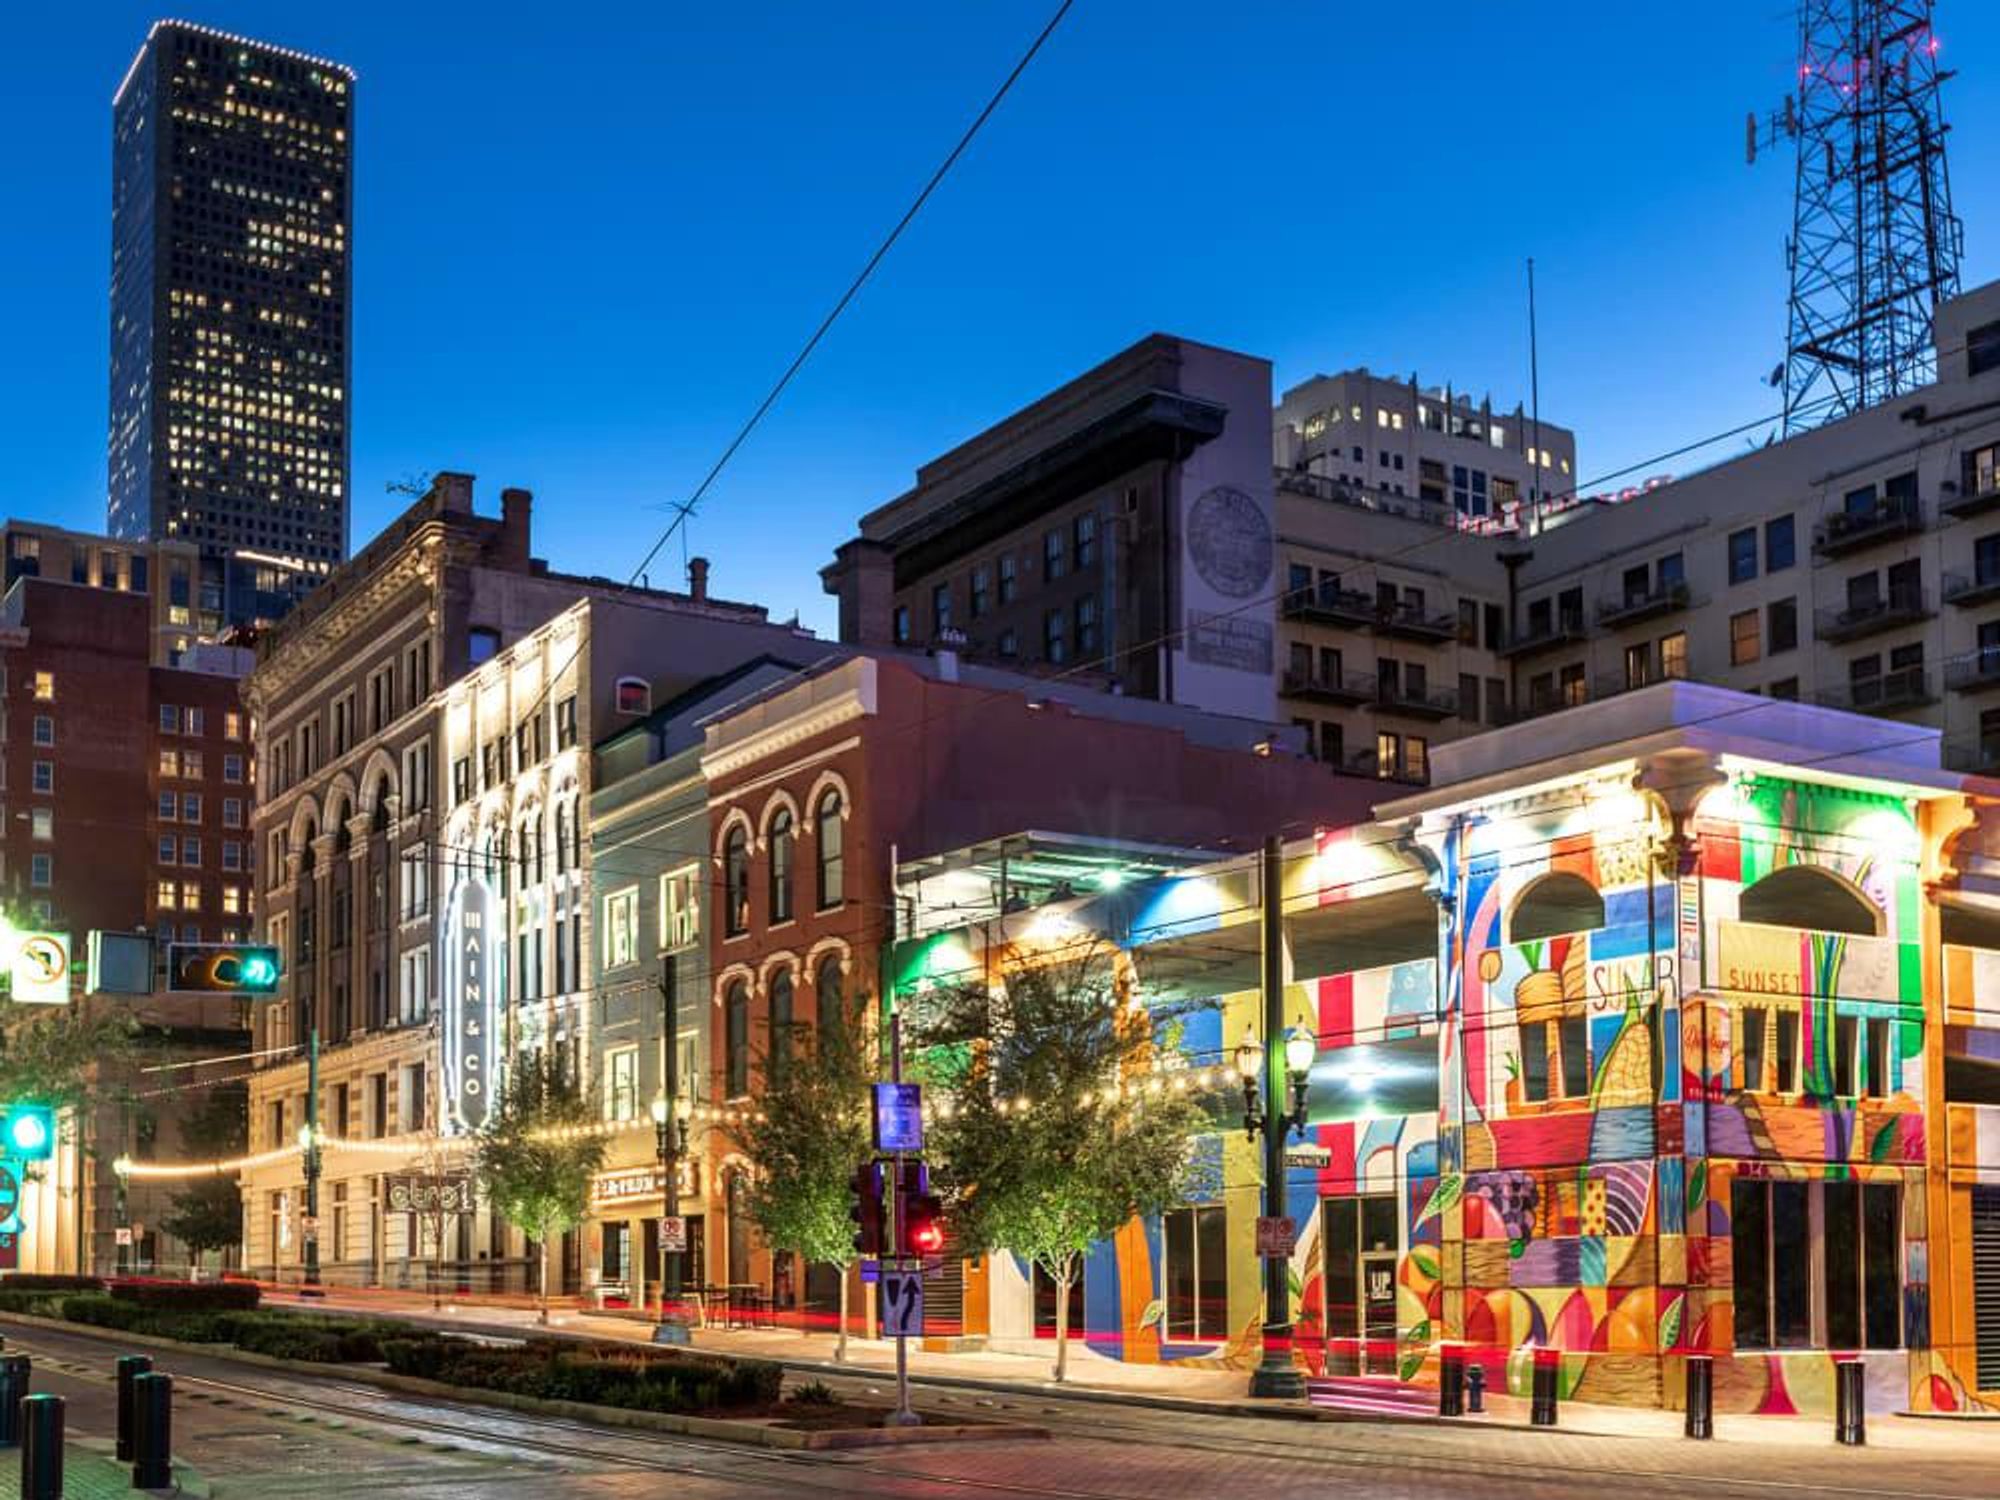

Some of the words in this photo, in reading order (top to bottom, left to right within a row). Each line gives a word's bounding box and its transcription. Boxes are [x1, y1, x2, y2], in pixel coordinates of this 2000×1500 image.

[465, 911, 481, 1001] MAIN
[1730, 968, 1800, 994] SUNSET
[465, 1020, 480, 1036] &
[465, 1054, 480, 1095] CO
